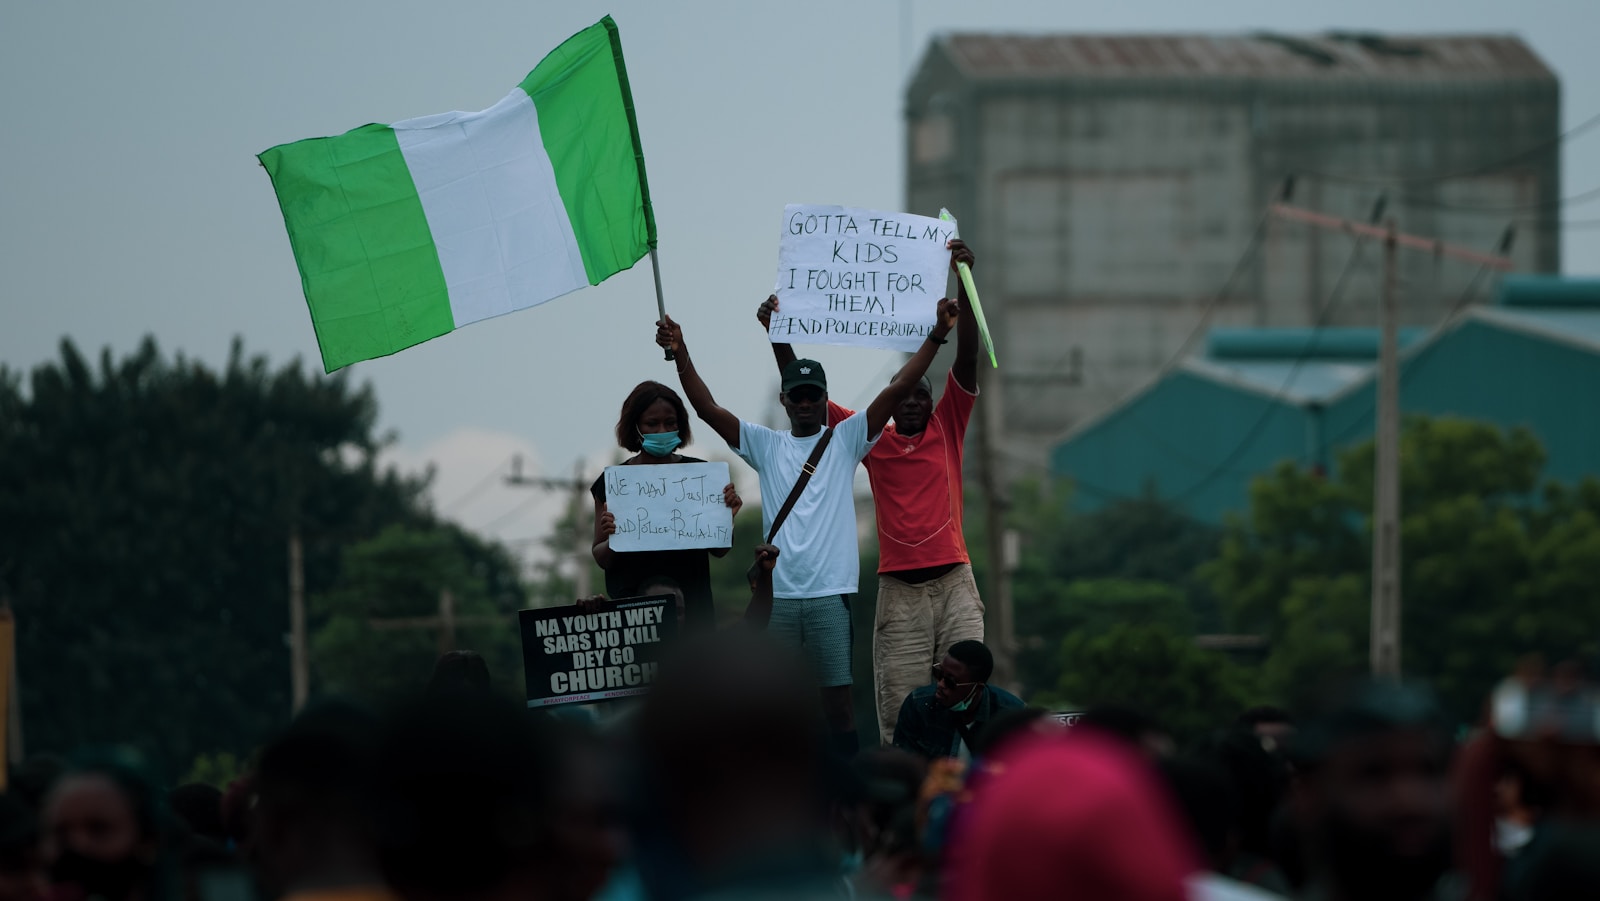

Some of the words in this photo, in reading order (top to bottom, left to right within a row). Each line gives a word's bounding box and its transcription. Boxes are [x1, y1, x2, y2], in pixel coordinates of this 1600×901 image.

[790, 212, 858, 235] GOTTA
[870, 218, 917, 240] TELL
[923, 226, 953, 246] MY
[832, 240, 898, 263] KIDS
[787, 268, 796, 289] I
[806, 269, 880, 290] FOUGHT
[888, 272, 926, 294] FOR
[607, 471, 629, 496] WE
[636, 478, 667, 498] WANT
[535, 618, 560, 637] NA
[562, 611, 622, 634] YOUTH
[624, 606, 664, 627] WEY
[543, 633, 592, 654] SARS
[595, 629, 620, 649] NO
[623, 625, 660, 645] KILL
[573, 649, 605, 669] DEY
[609, 646, 635, 665] GO
[550, 662, 658, 694] CHURCH
